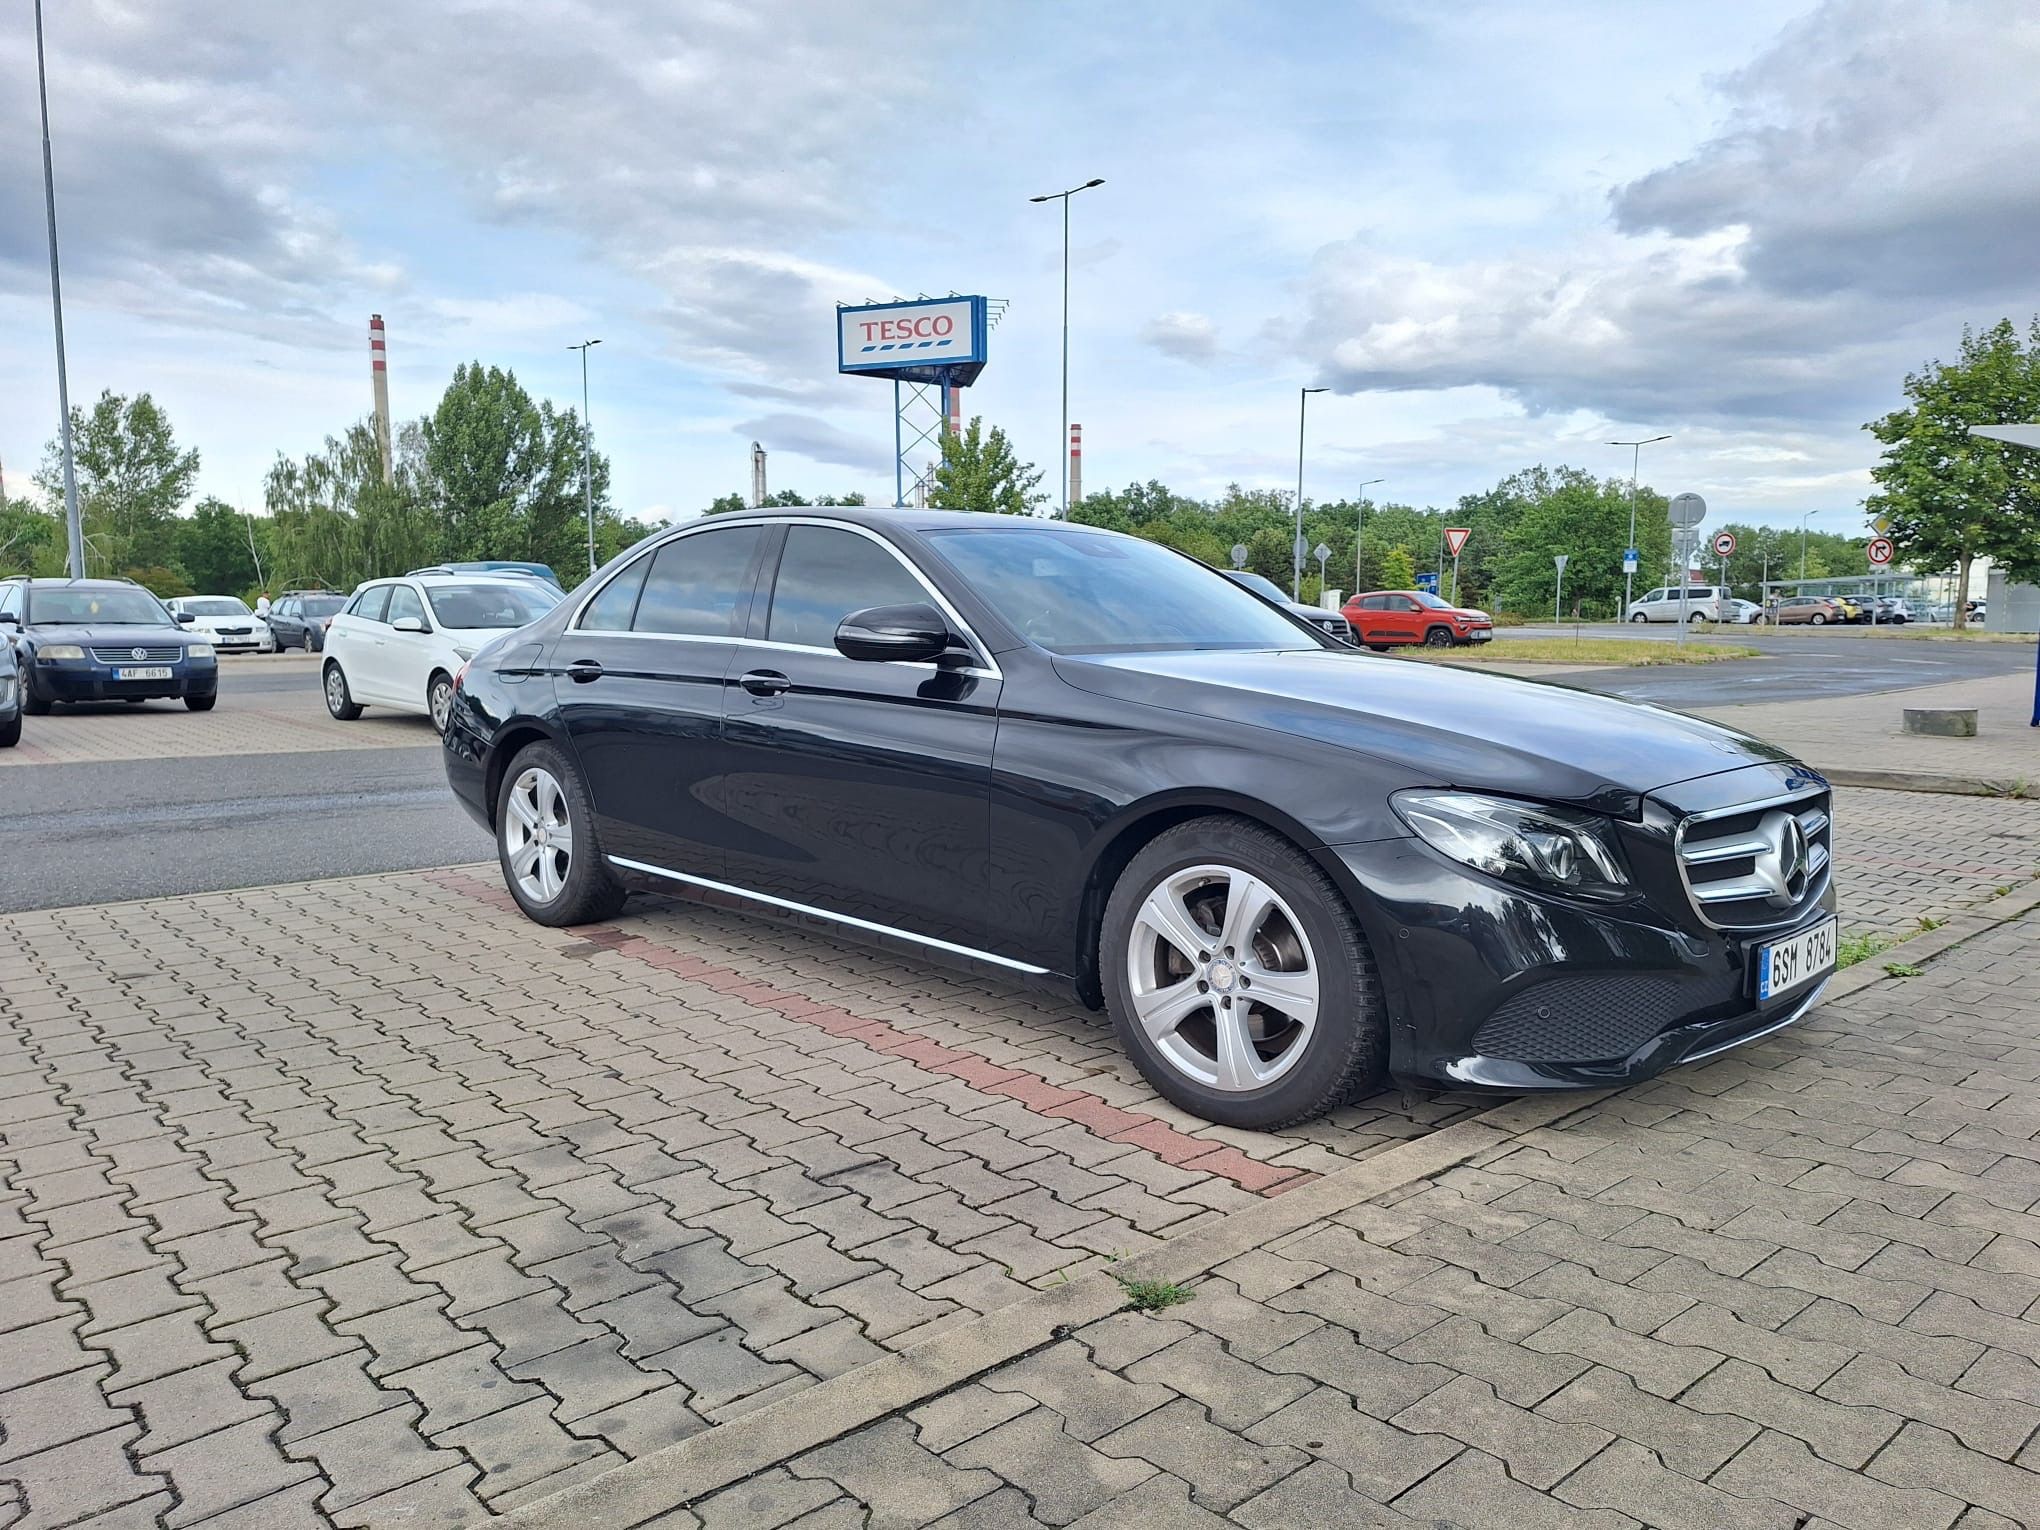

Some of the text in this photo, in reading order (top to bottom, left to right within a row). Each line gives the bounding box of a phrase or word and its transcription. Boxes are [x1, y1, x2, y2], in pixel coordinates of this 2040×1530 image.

[859, 315, 953, 342] TESCO
[121, 669, 136, 678] 4AF
[1773, 926, 1831, 988] 6SM 8784
[1760, 980, 1769, 994] CZ
